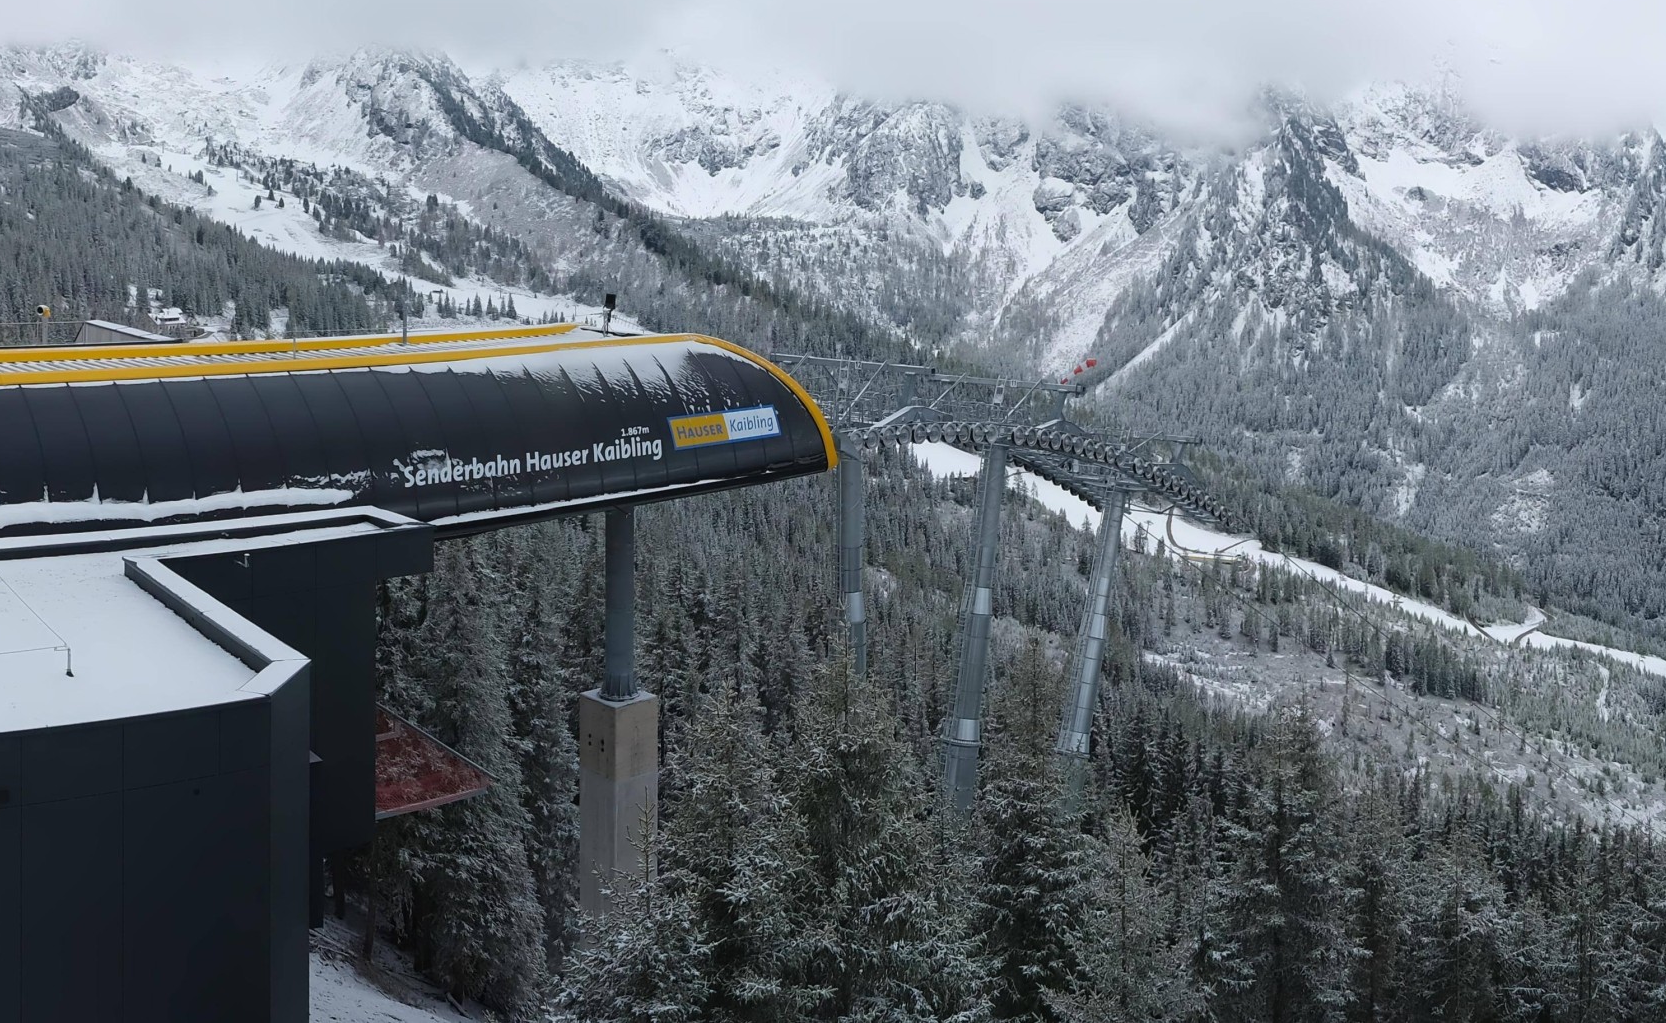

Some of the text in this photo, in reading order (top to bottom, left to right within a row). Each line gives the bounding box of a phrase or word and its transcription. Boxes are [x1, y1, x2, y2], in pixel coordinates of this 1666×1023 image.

[620, 426, 650, 437] 1.867m
[676, 415, 774, 440] HAUSER Kaibling
[404, 436, 663, 488] Senderbahn Hauser Kaibling
